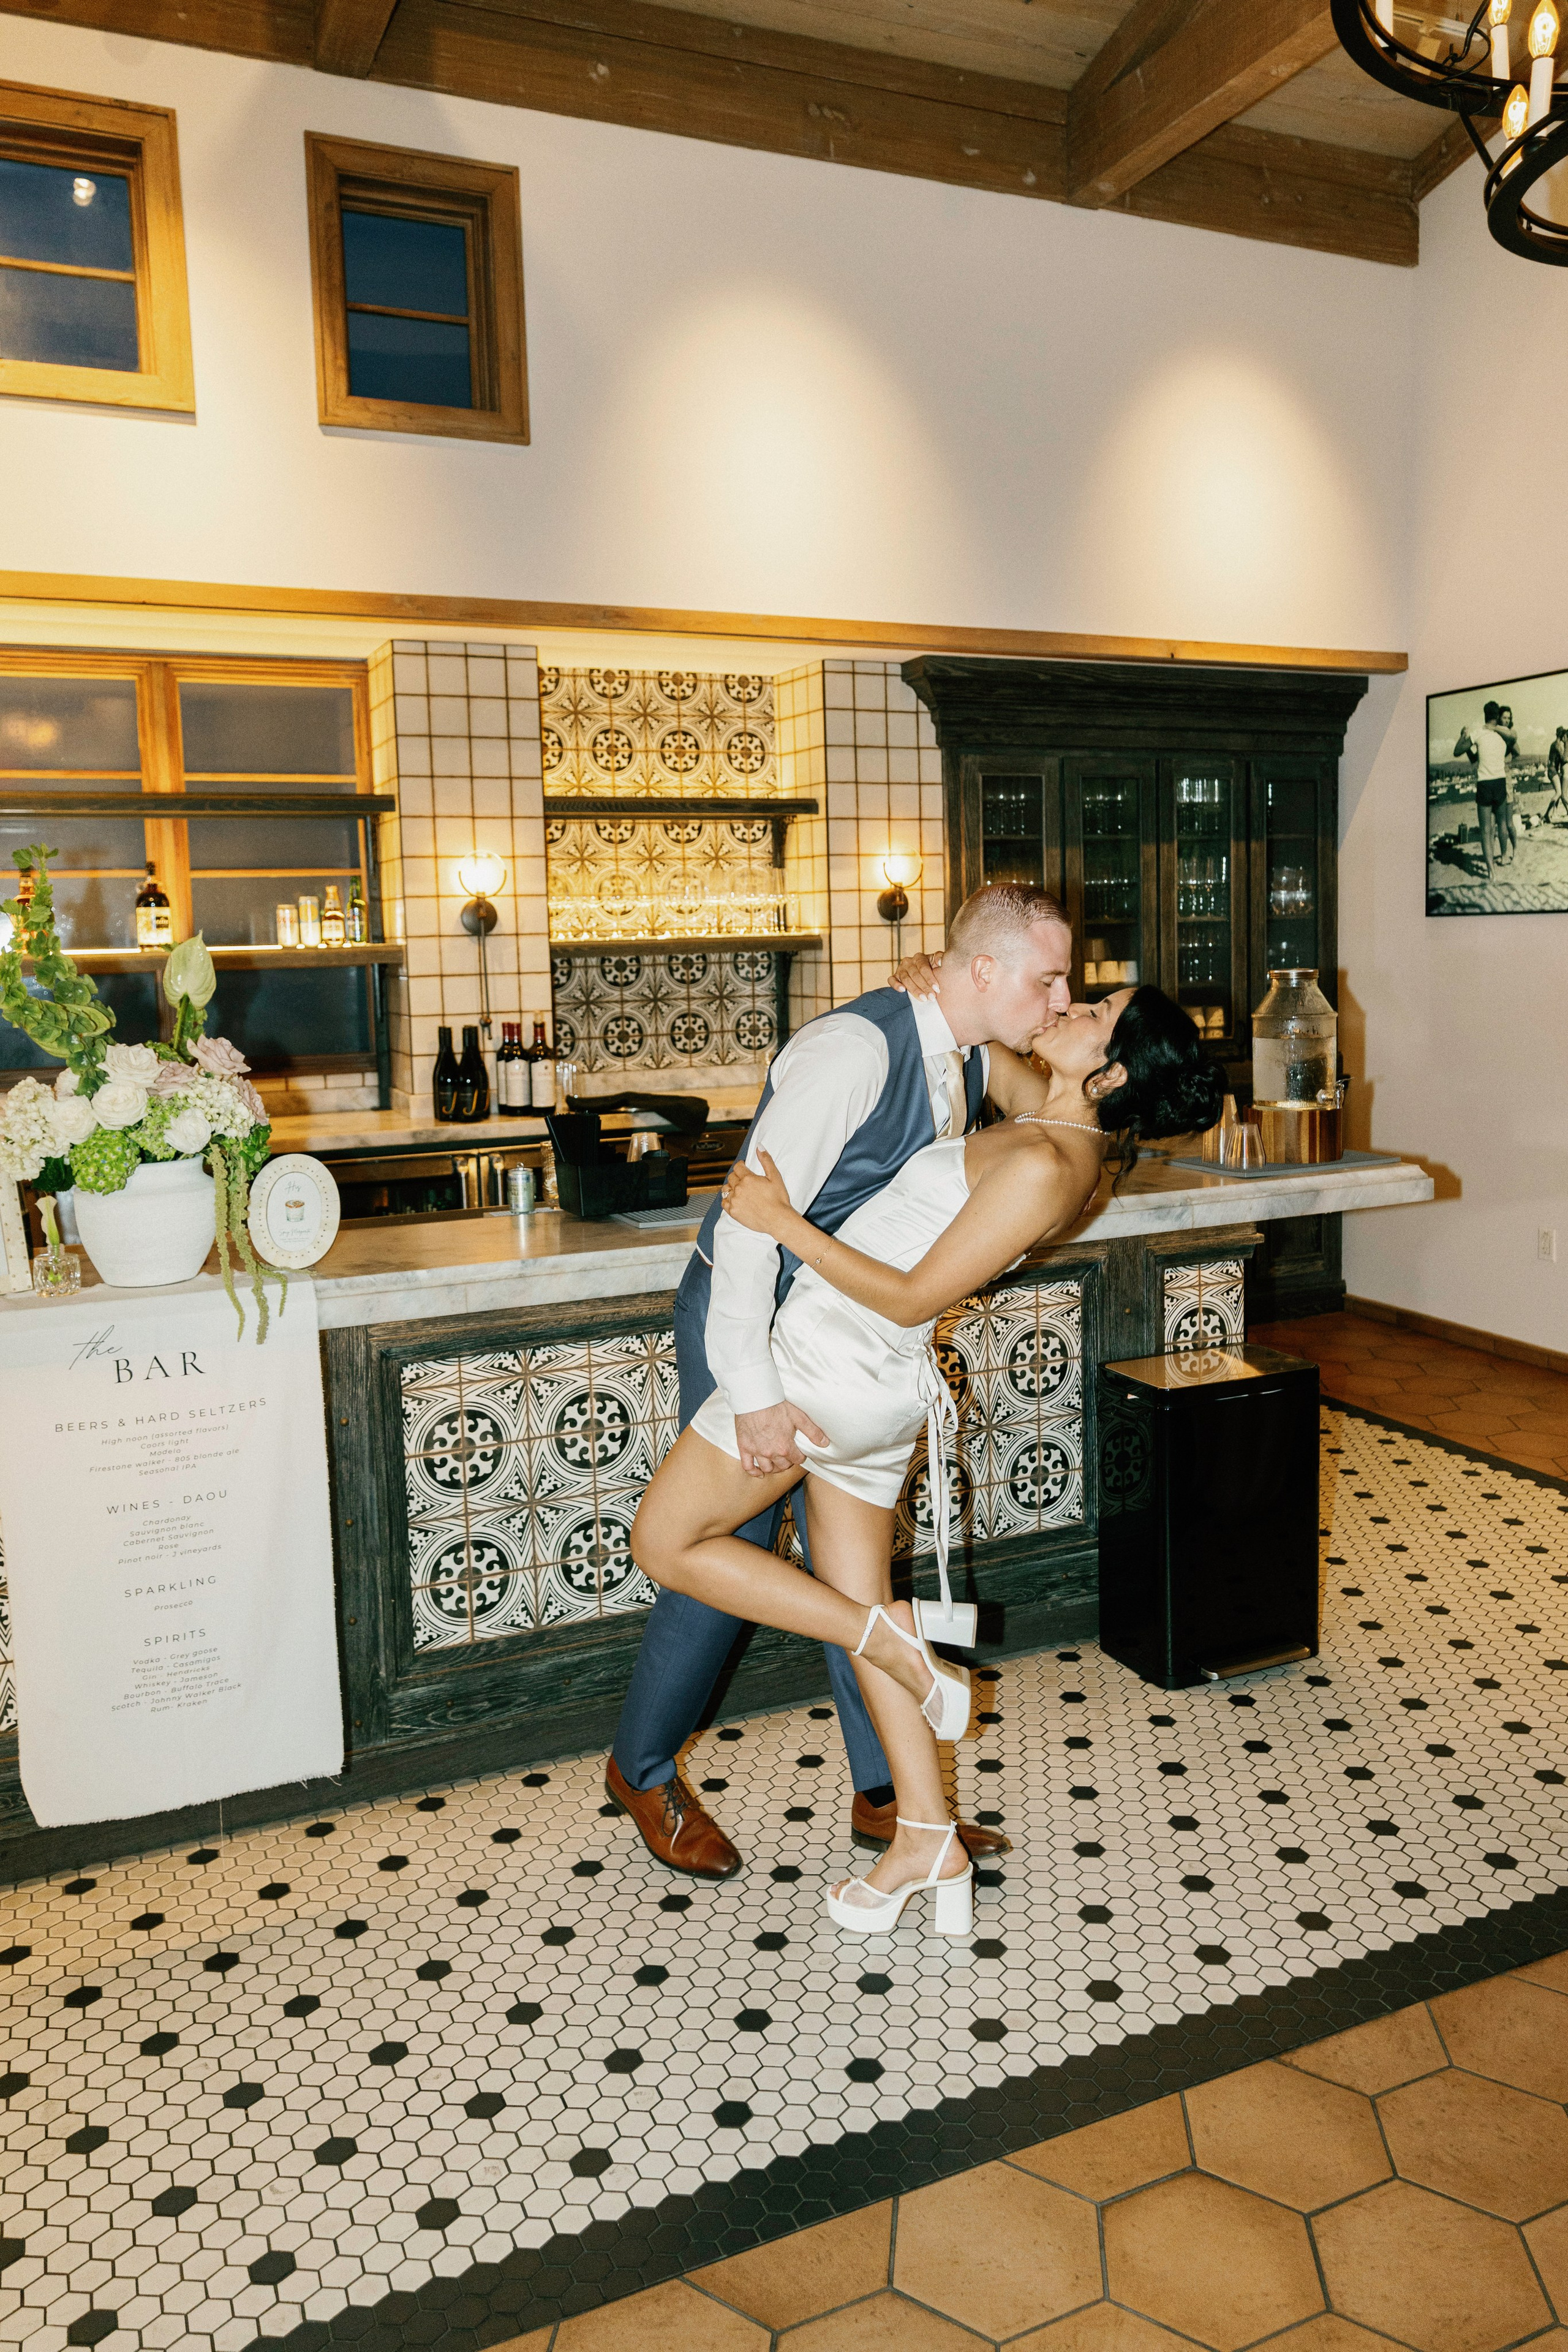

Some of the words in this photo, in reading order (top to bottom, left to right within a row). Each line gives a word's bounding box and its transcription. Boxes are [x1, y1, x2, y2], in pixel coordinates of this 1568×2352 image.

[69, 1325, 123, 1370] the
[113, 1351, 206, 1384] BAR
[55, 1421, 108, 1432] BEERS
[135, 1412, 179, 1425] HARD
[189, 1398, 266, 1418] SELTZERS
[152, 1429, 192, 1439] (assorted
[141, 1441, 165, 1449] Coors
[149, 1448, 181, 1457] Modelo
[89, 1463, 132, 1473] Firestone
[135, 1458, 165, 1467] walker
[194, 1451, 223, 1460] blonde
[138, 1466, 178, 1476] Seasonal
[107, 1500, 160, 1514] WINES
[184, 1490, 227, 1504] DAOU
[143, 1515, 191, 1526] Chardonay
[123, 1536, 164, 1547] Cabernet
[168, 1529, 214, 1540] Sauvignon
[130, 1526, 176, 1537] Sauvignon
[118, 1556, 141, 1565] Pinot
[180, 1544, 222, 1556] vineyards
[124, 1575, 216, 1597] SPARKLING
[154, 1600, 193, 1611] Prosecco
[144, 1629, 206, 1646] SPIRITS
[192, 1647, 218, 1657] goose
[131, 1665, 164, 1674] Tequila
[173, 1656, 221, 1668] Casamigos
[167, 1665, 210, 1677] Hendricks
[135, 1681, 170, 1689] Whiskey
[180, 1672, 218, 1683] Jameson
[111, 1700, 140, 1711] Scotch
[150, 1695, 181, 1704] Johnny
[186, 1689, 215, 1698] Walker
[219, 1683, 241, 1692] Black
[124, 1689, 161, 1700] Bourbon
[171, 1683, 202, 1693] Buffalo
[177, 1698, 207, 1708] Kraken
